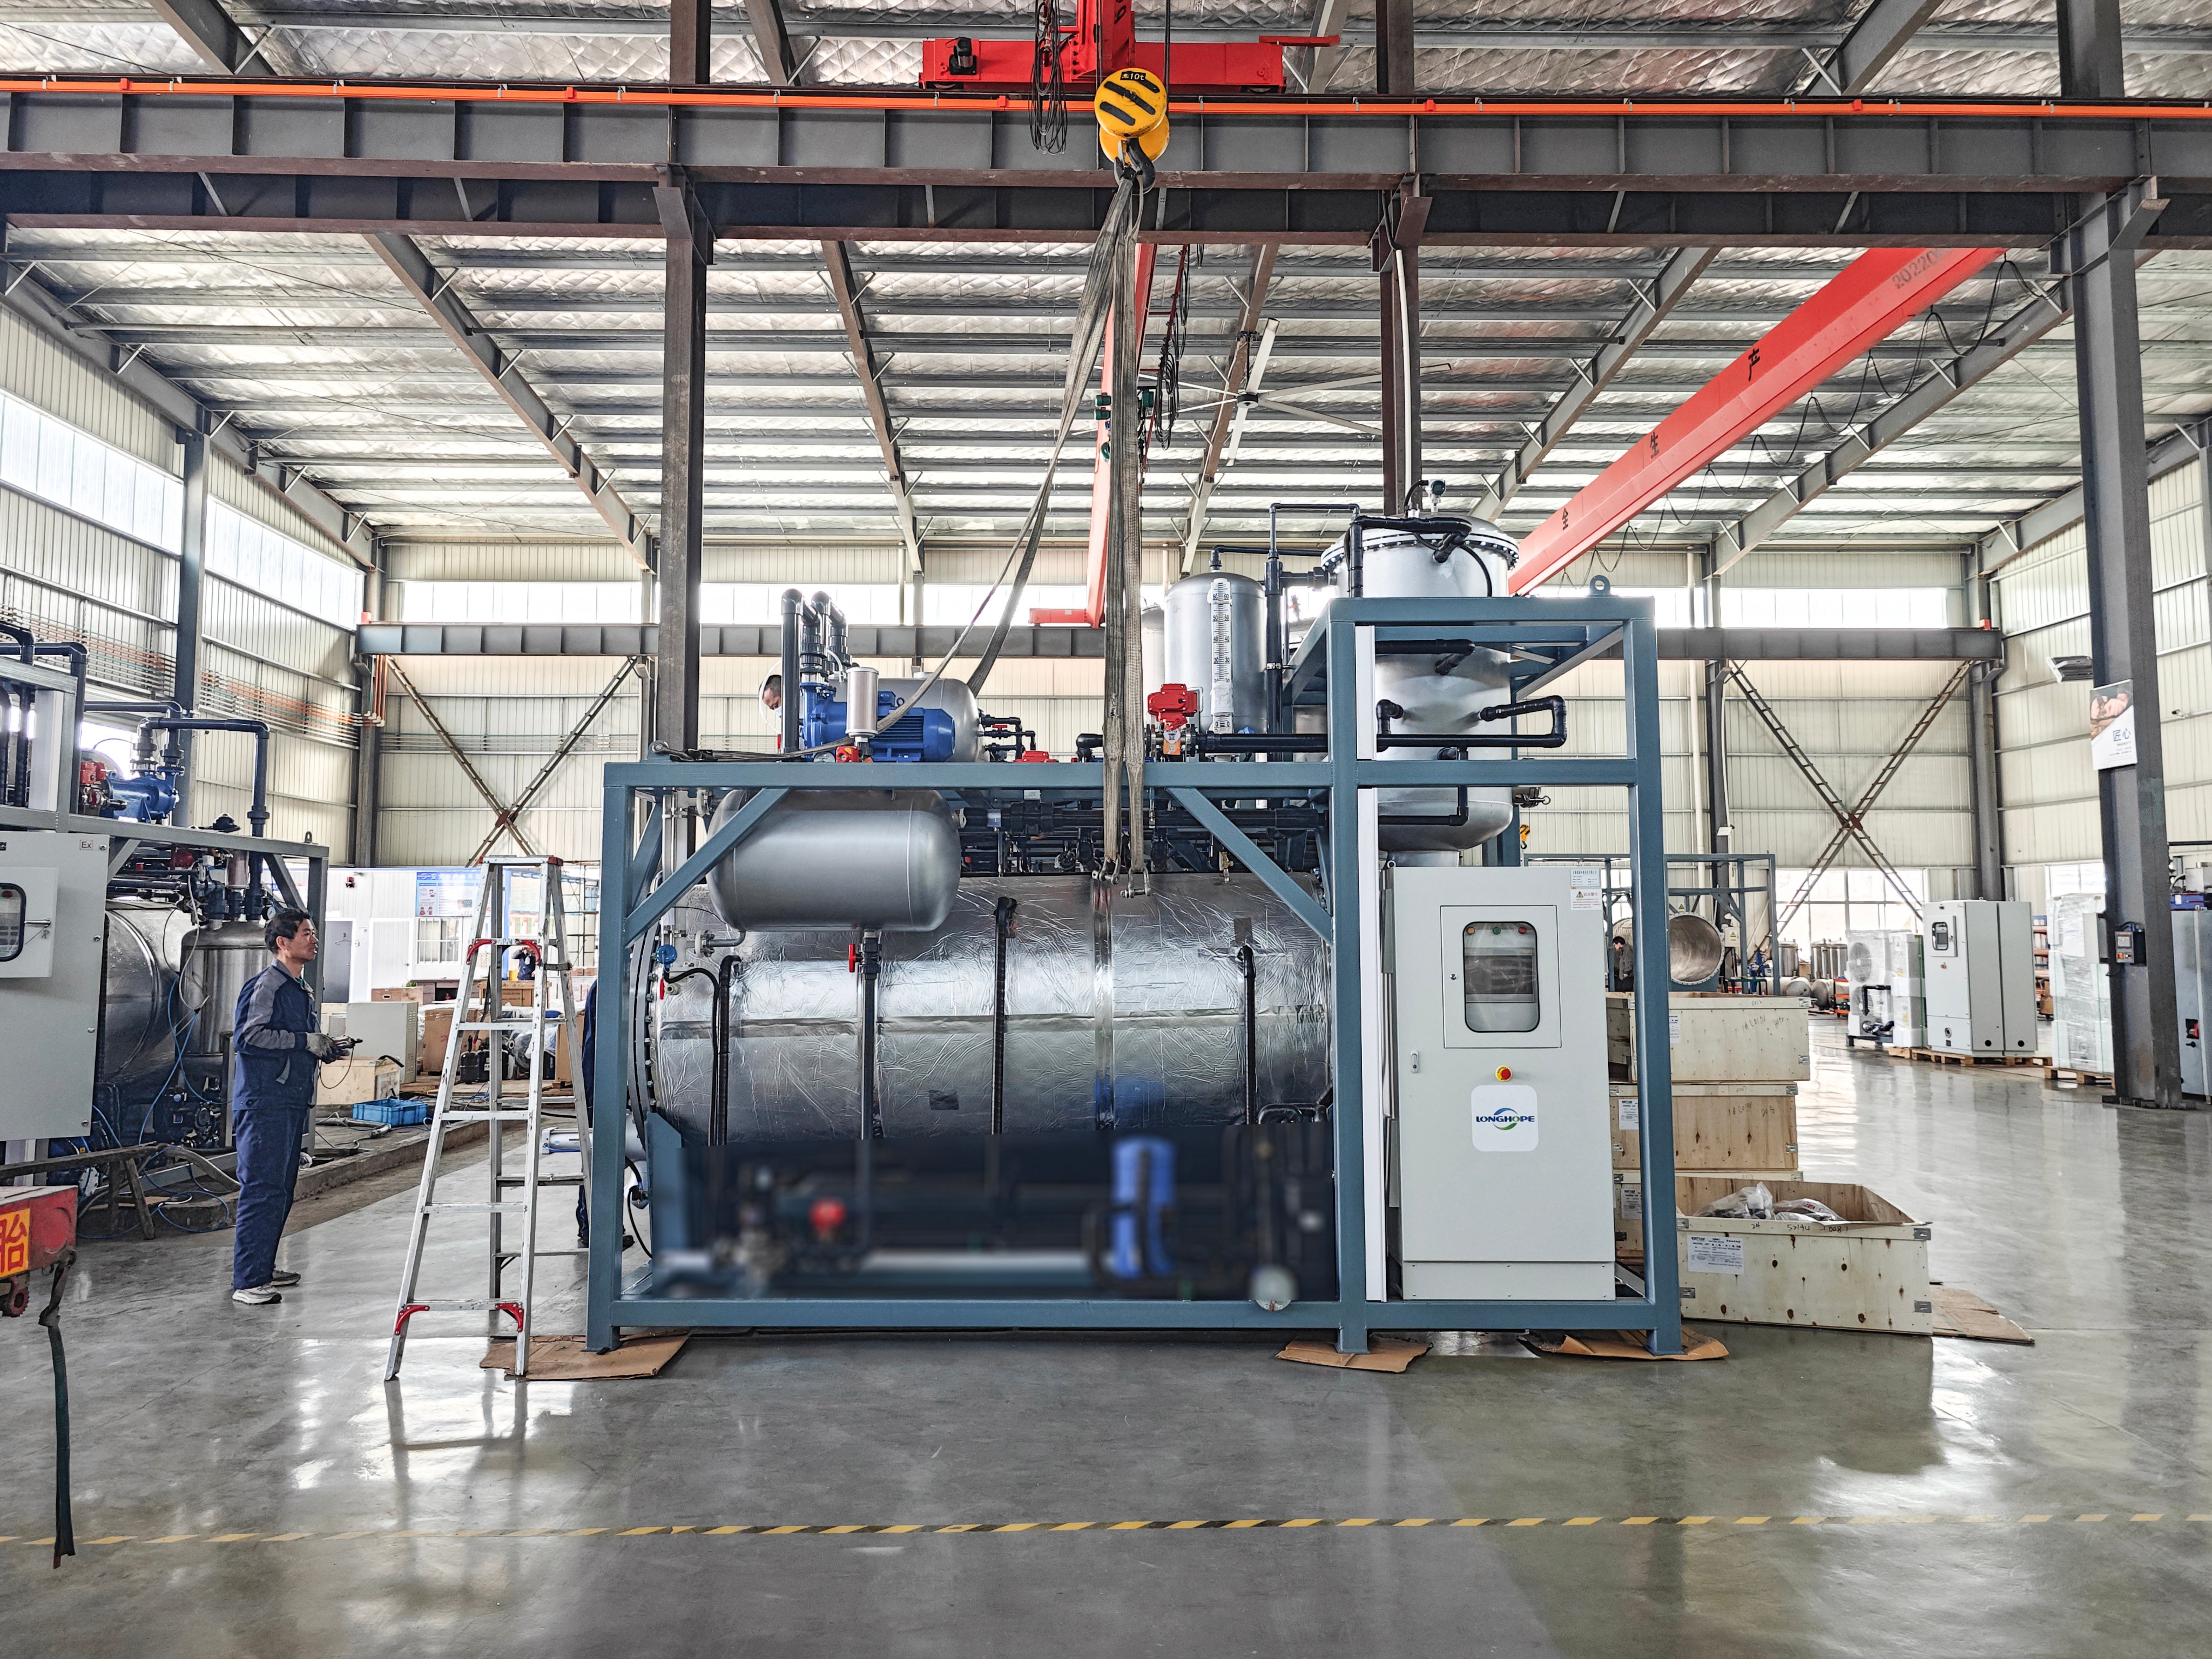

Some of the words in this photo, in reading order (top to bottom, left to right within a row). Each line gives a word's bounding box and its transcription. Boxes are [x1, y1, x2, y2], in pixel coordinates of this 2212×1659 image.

[1562, 508, 1569, 530] 全
[1650, 431, 1660, 459] 生
[1748, 348, 1761, 382] 产
[2113, 727, 2131, 741] 匠心
